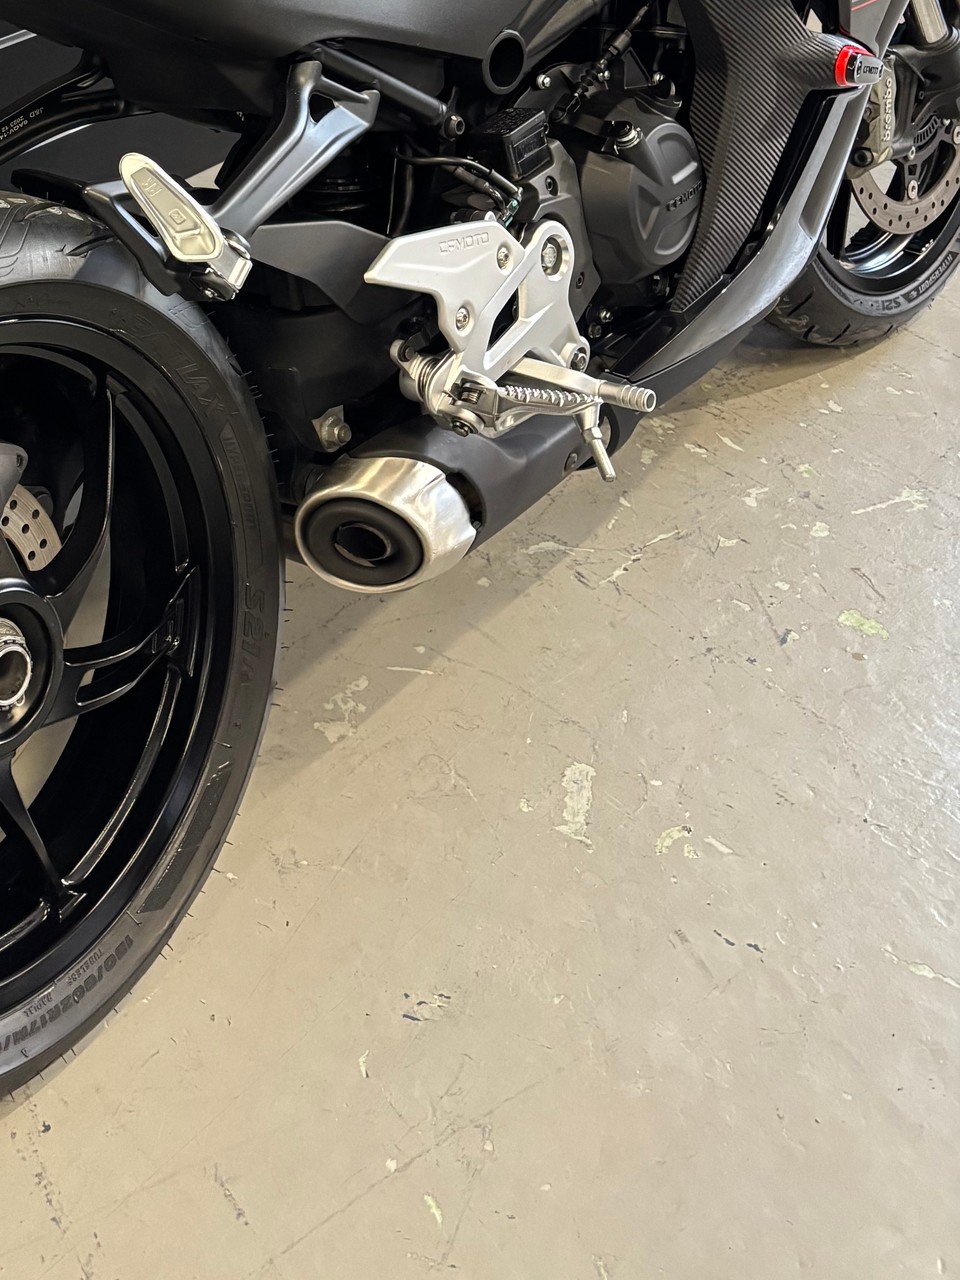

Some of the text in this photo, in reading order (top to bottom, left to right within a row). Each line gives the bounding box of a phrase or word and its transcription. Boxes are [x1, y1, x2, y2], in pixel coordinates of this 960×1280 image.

[863, 65, 879, 75] CFMOTO
[883, 78, 893, 142] brembo
[666, 180, 703, 211] CFMOTO
[439, 231, 490, 254] CFMOTO
[918, 253, 953, 294] HYPERSPORT
[880, 296, 902, 311] S21
